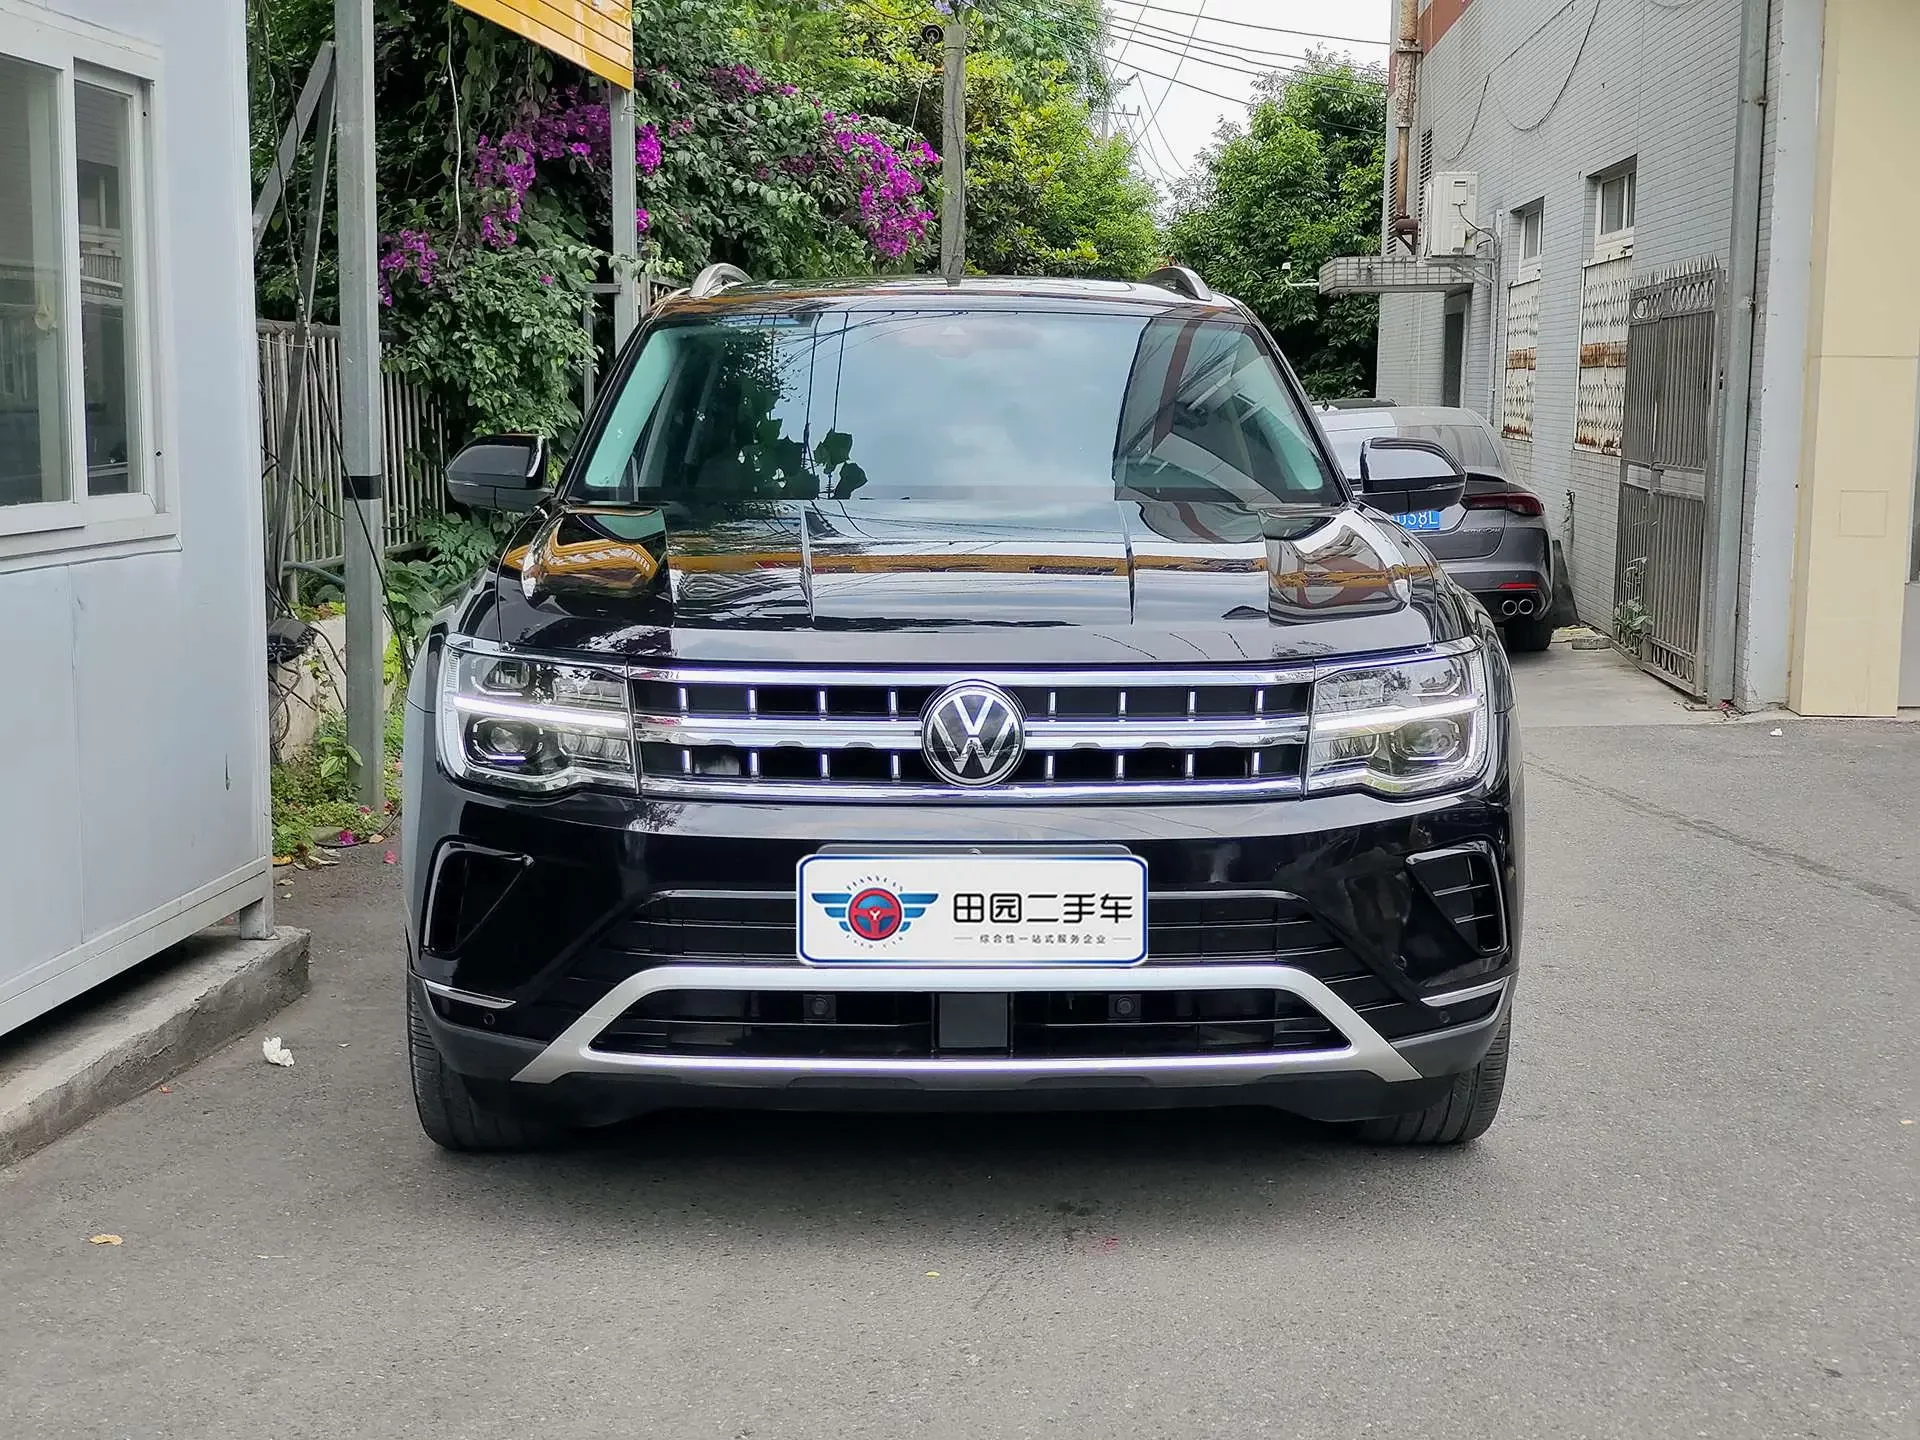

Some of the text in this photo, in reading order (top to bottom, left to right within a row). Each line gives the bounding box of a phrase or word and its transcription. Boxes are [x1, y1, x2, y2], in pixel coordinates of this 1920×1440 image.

[929, 689, 1018, 778] VW
[953, 892, 1133, 924] 田园二手车
[979, 933, 1107, 945] 综合性一站式服务企业
